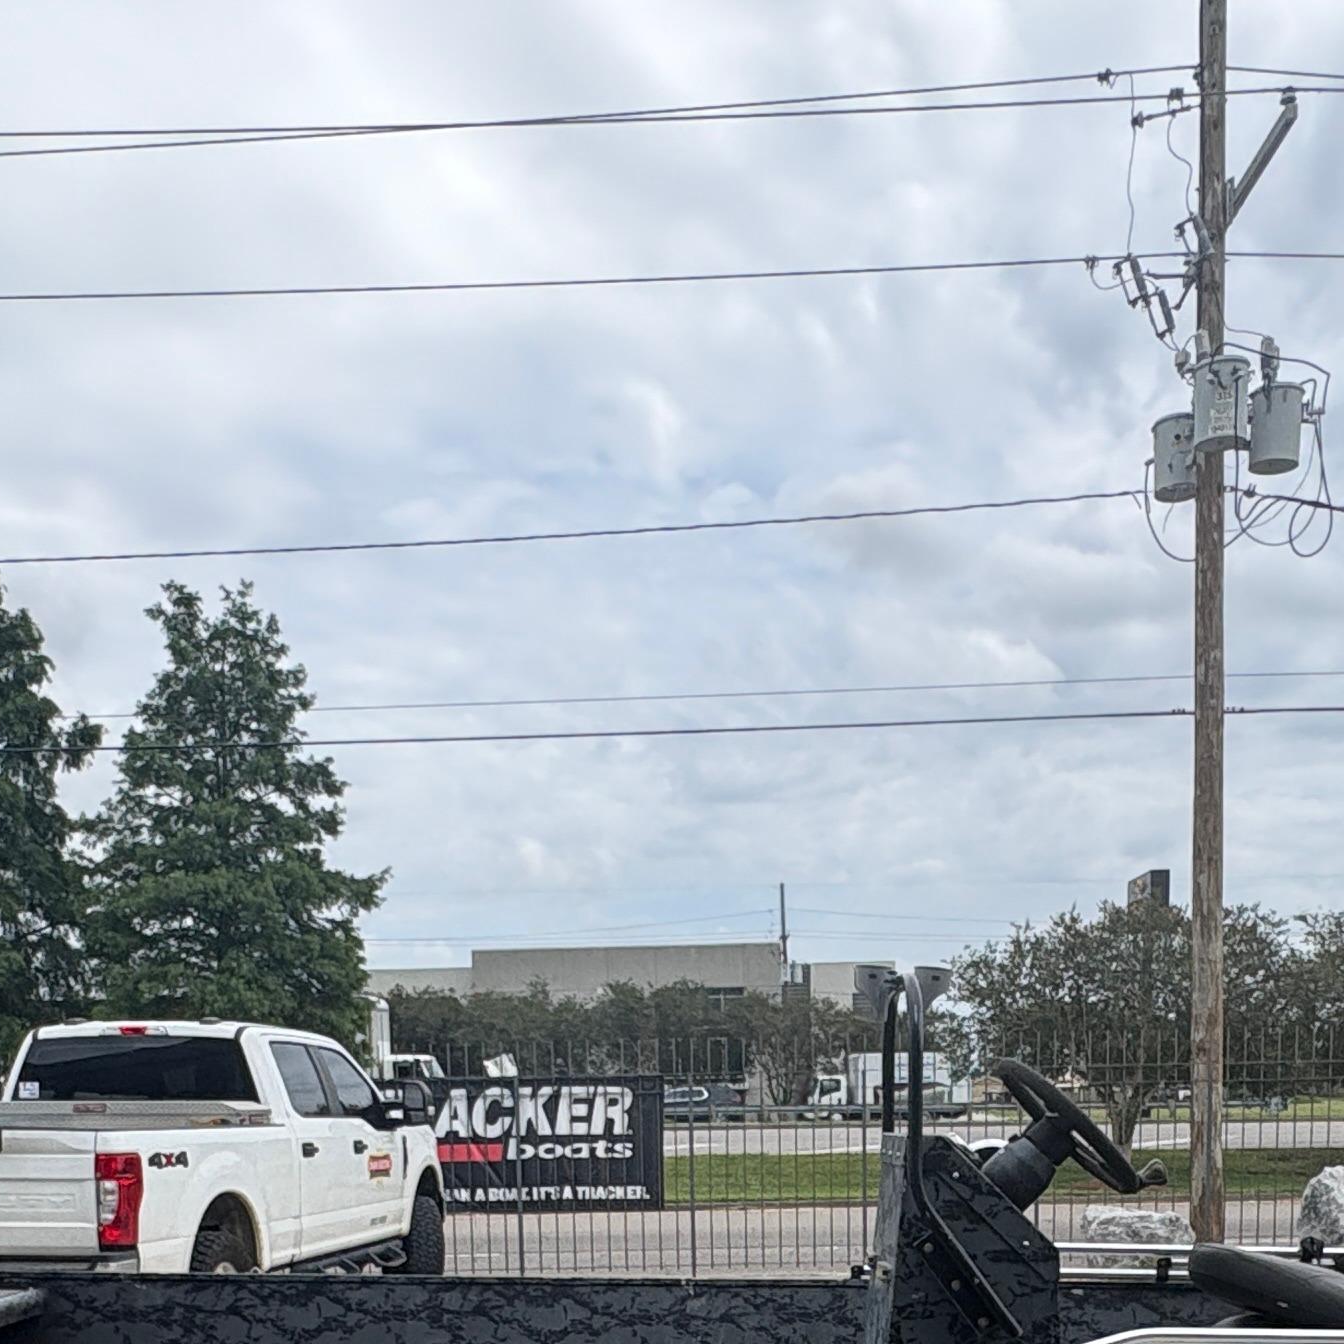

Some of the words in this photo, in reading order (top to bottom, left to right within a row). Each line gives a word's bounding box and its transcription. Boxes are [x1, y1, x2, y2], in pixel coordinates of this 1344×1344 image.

[507, 1138, 634, 1160] boats
[474, 1187, 487, 1201] A
[562, 1185, 575, 1200] A
